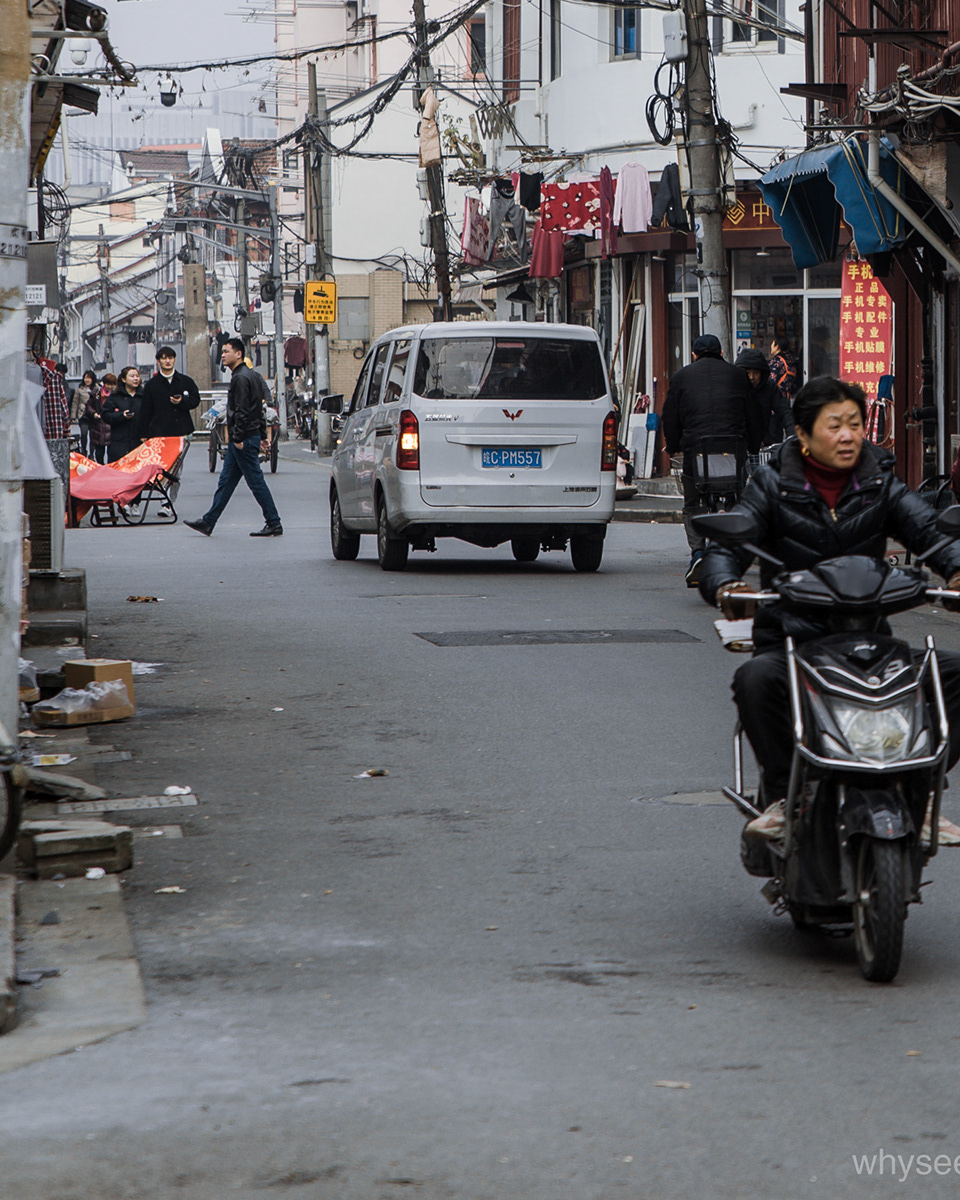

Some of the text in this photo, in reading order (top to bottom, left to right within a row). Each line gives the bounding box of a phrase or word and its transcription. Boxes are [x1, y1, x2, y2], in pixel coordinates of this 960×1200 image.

[855, 282, 879, 293] 正品
[842, 294, 887, 307] 手机专卖
[842, 311, 887, 324] 手机配件
[855, 326, 879, 338] 专业
[844, 341, 885, 354] 手机贴膜
[844, 361, 885, 374] 手机维修
